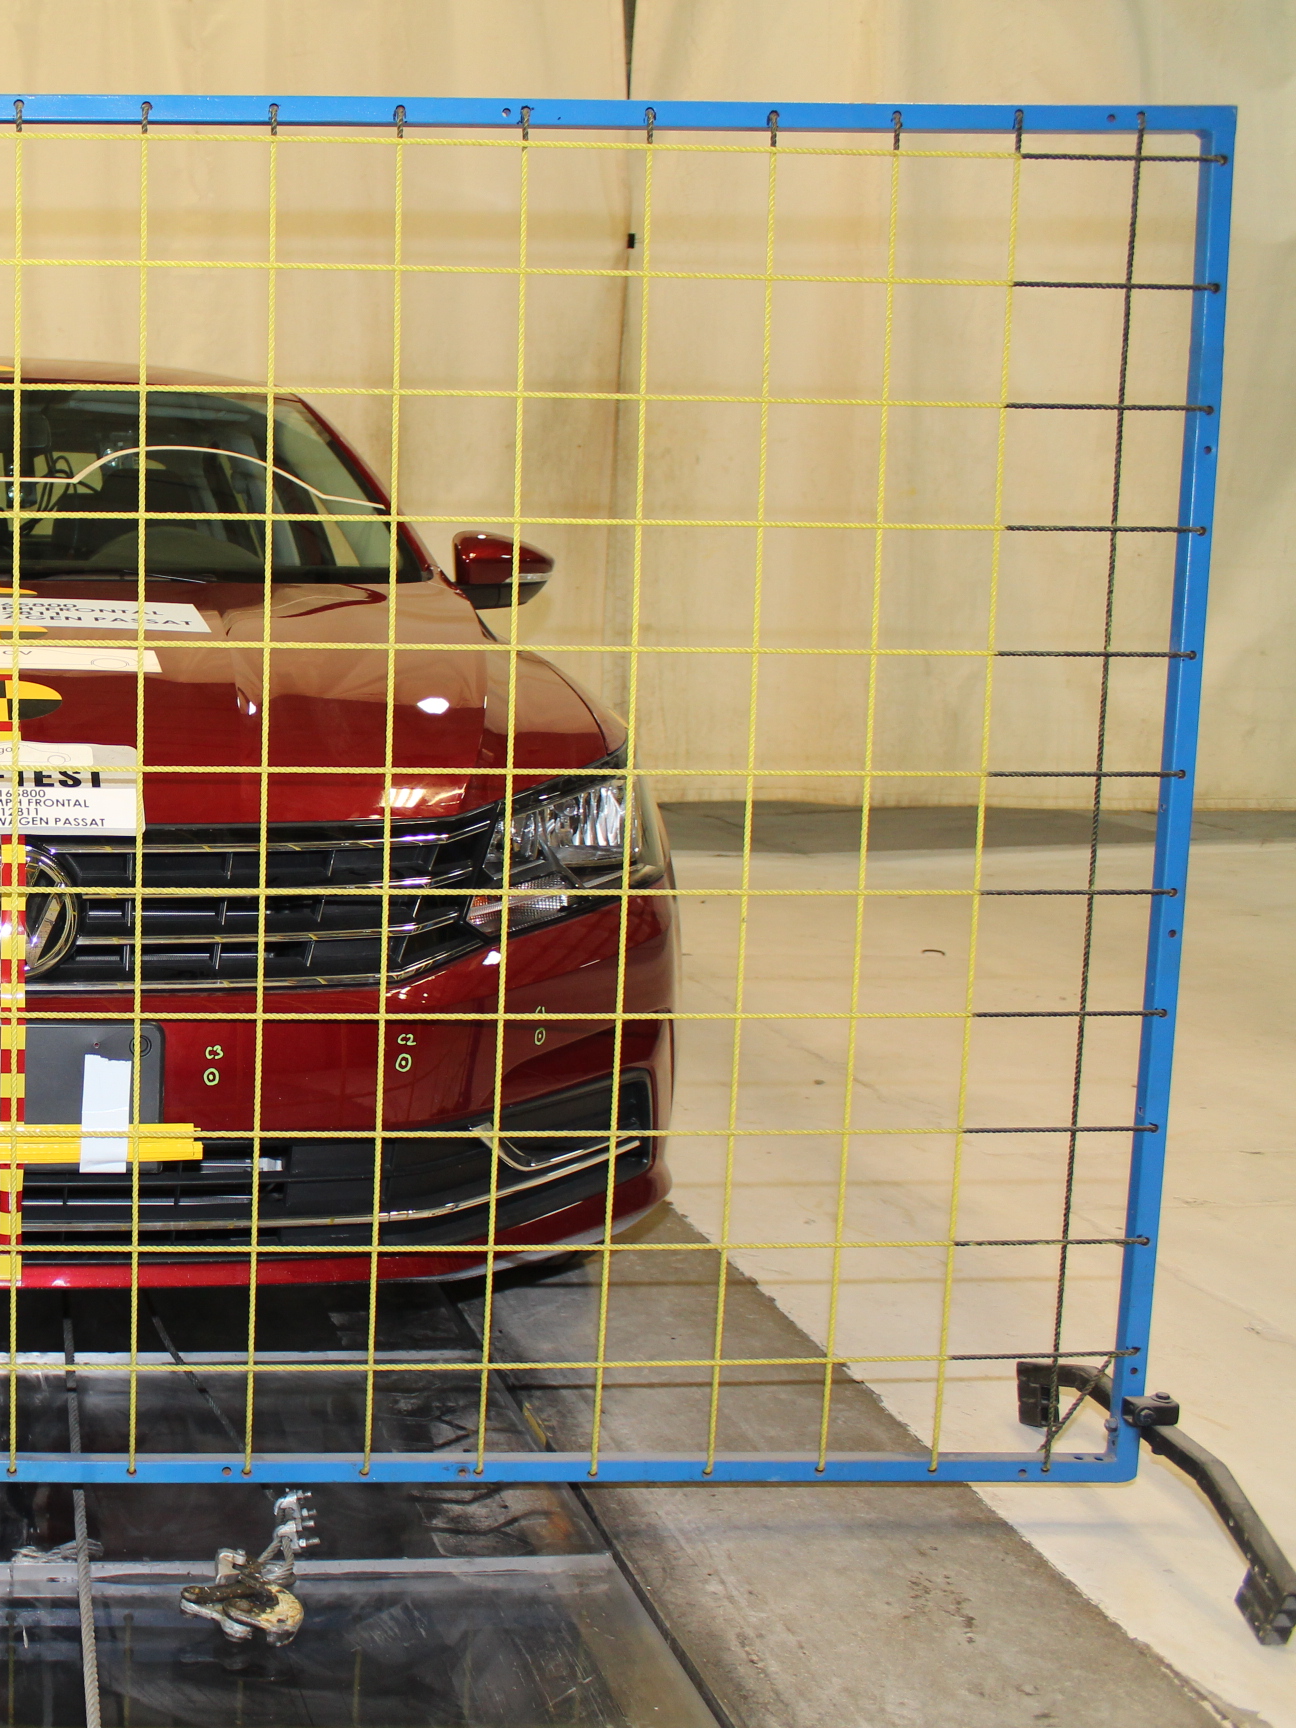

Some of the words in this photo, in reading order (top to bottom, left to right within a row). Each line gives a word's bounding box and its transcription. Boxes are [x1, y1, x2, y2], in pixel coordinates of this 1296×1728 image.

[45, 606, 164, 616] FRONTAL
[93, 616, 193, 626] PASSAT
[27, 798, 90, 808] FRONTAL
[54, 817, 106, 827] PASSAT
[397, 1033, 417, 1046] C2
[205, 1044, 224, 1060] C3
